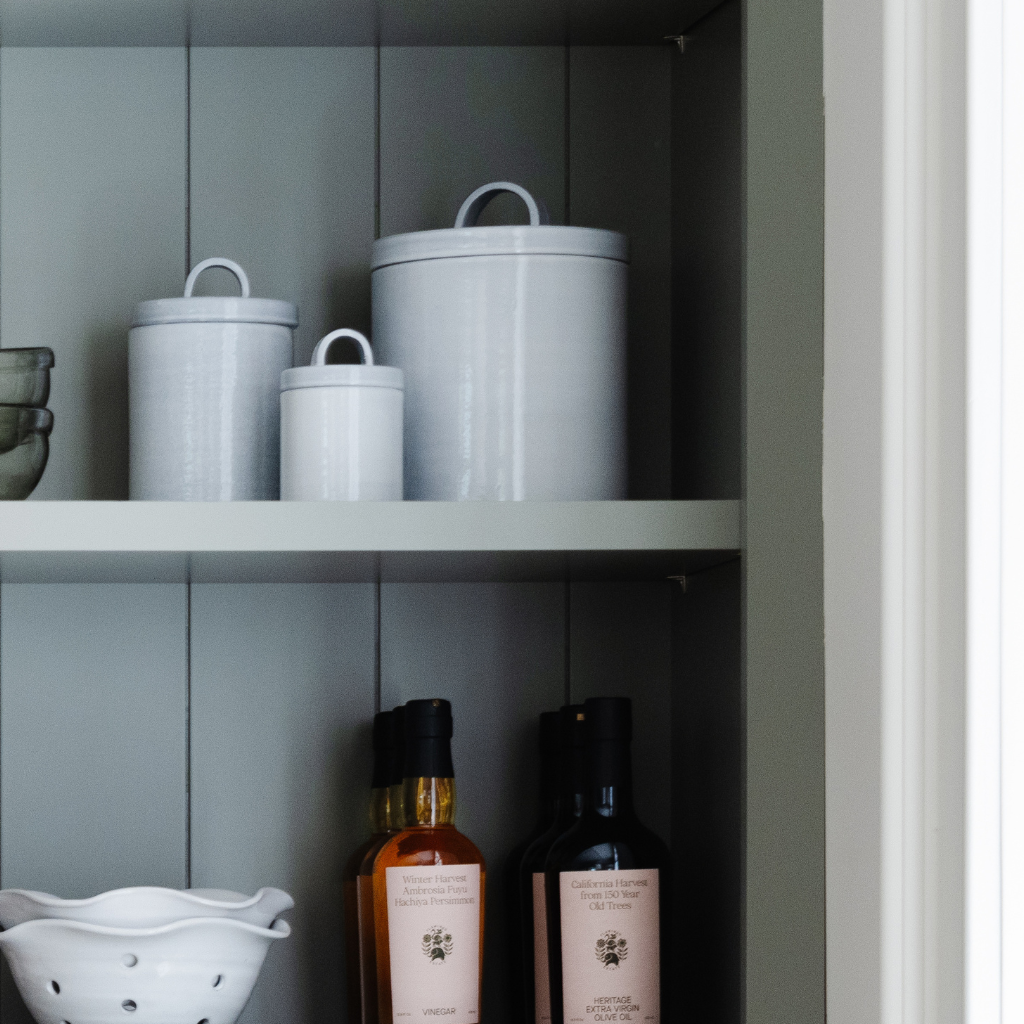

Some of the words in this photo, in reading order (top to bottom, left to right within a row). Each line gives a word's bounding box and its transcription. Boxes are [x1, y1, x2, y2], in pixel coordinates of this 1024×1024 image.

[402, 875, 432, 884] Winter
[435, 874, 467, 884] Harvest
[571, 879, 613, 889] California
[615, 878, 648, 888] Harvest
[402, 886, 445, 896] Ambrosia
[447, 885, 468, 895] Fuyu
[580, 890, 602, 900] from
[604, 890, 619, 899] 150
[621, 889, 640, 899] Year
[394, 896, 428, 908] Hachiya
[430, 896, 475, 906] Persimmon
[588, 901, 605, 911] Old
[606, 901, 632, 910] Trees
[593, 996, 632, 1005] HERITAGE
[422, 1008, 456, 1016] VINEGAR
[586, 1005, 612, 1014] EXTRA
[613, 1004, 640, 1013] VIRGIN
[594, 1013, 618, 1022] OLIVE
[619, 1013, 632, 1021] OIL
